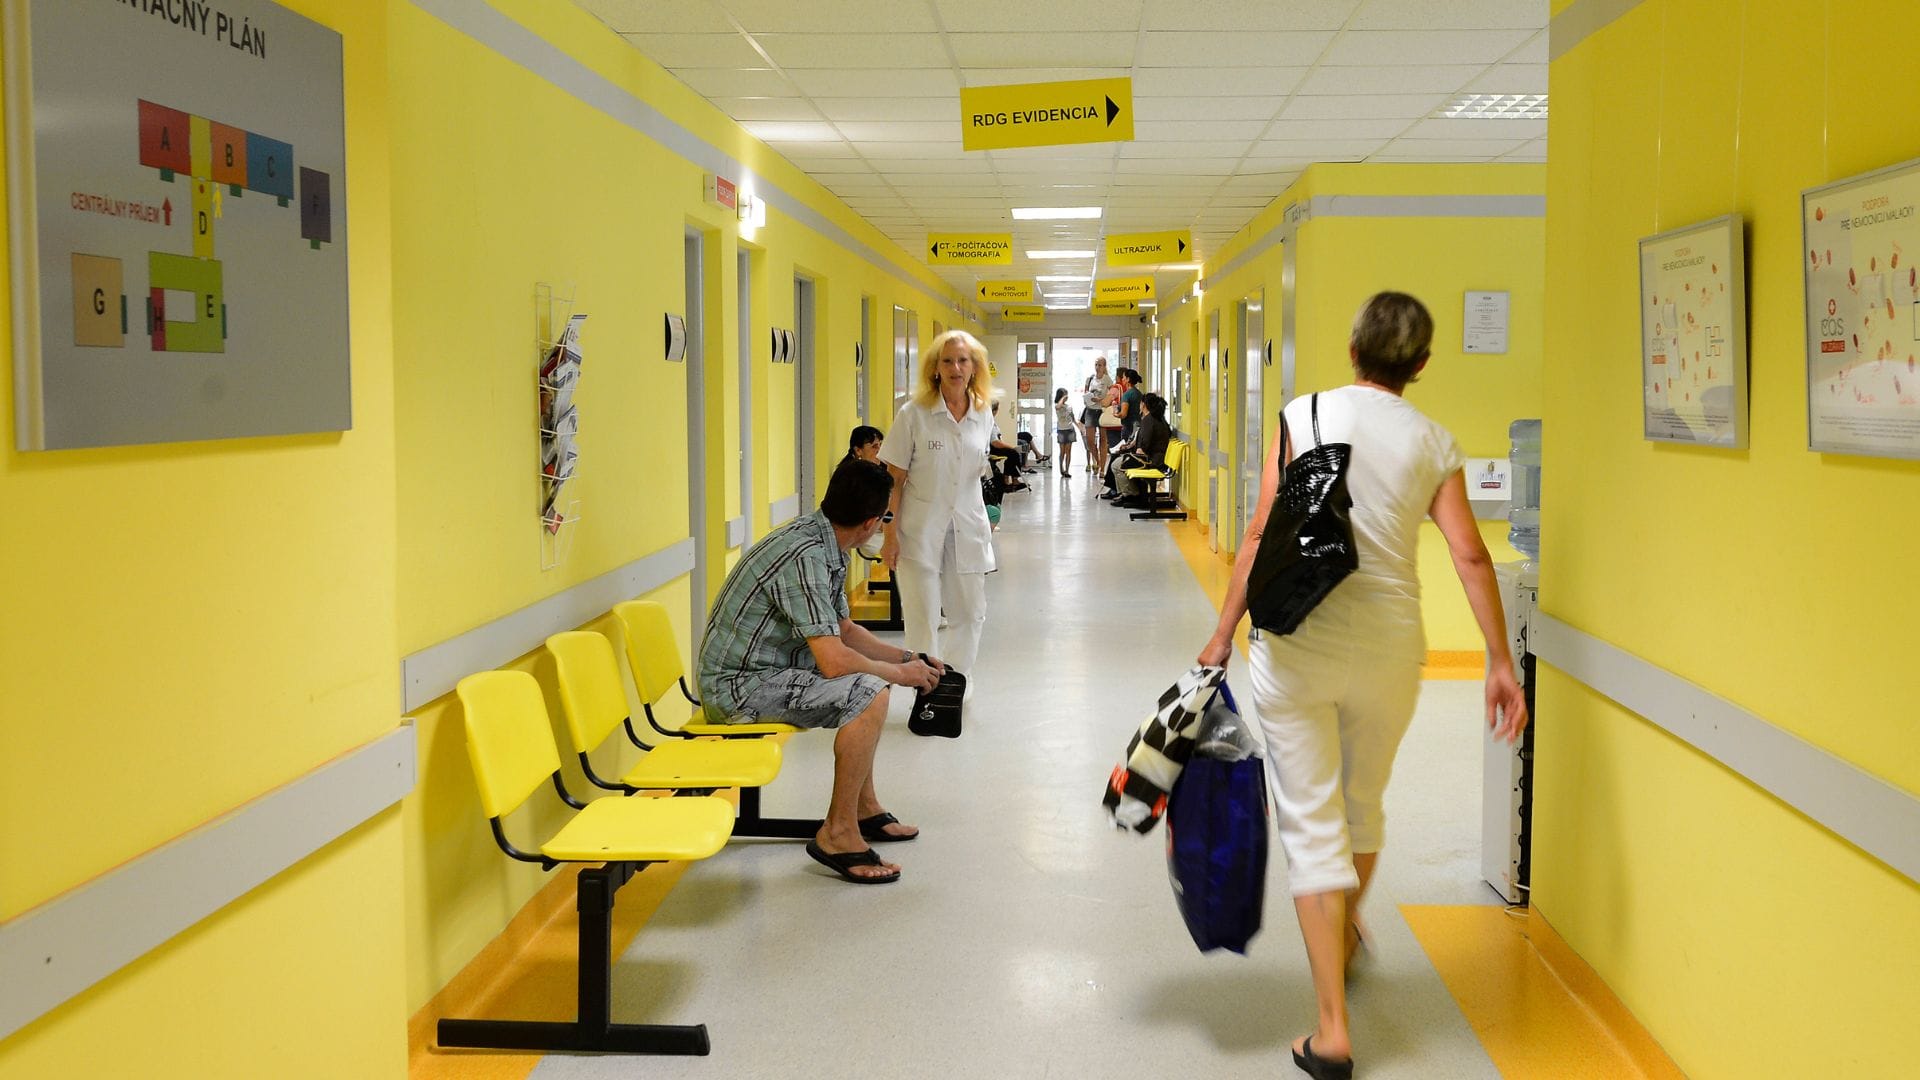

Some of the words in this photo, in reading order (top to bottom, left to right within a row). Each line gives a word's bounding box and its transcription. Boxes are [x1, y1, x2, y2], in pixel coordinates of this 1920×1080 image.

[217, 11, 265, 59] PLÁN
[973, 113, 1007, 127] RDG
[1012, 106, 1099, 124] EVIDENCIA
[161, 126, 170, 151] A
[225, 143, 234, 168] B
[267, 156, 275, 178] C
[71, 191, 127, 217] CENTRÁLNY
[199, 211, 207, 235] D
[939, 242, 950, 250] CT
[948, 251, 1001, 259] TOMOGRAFIA
[1114, 244, 1162, 255] ULTRAZVUK
[1102, 285, 1141, 293] MAMOGRAFIA
[93, 288, 105, 315] G
[206, 294, 214, 318] E
[153, 306, 163, 331] H
